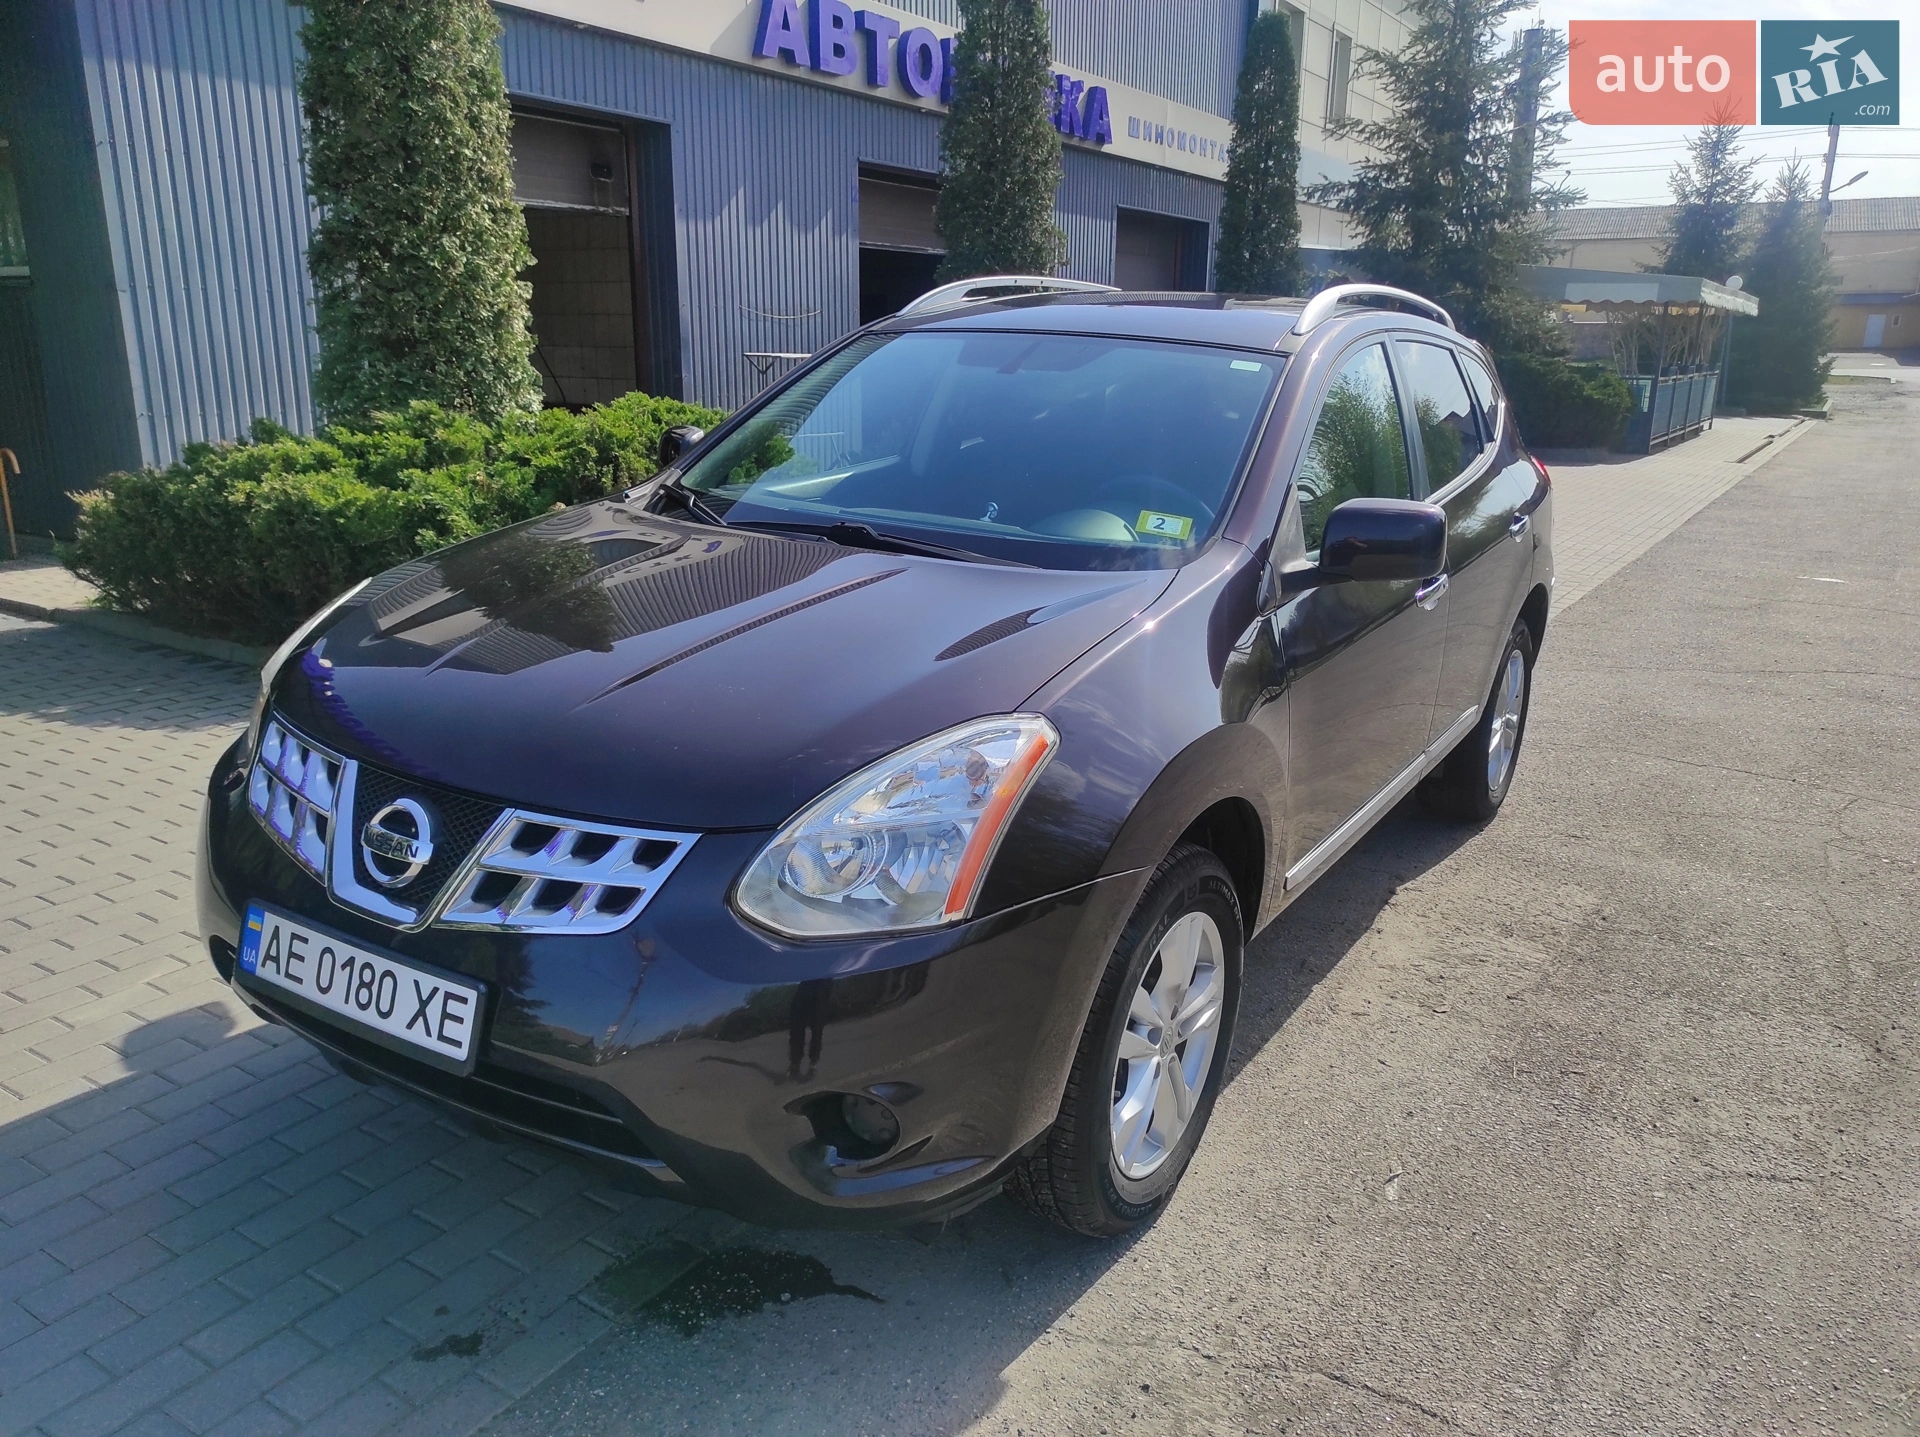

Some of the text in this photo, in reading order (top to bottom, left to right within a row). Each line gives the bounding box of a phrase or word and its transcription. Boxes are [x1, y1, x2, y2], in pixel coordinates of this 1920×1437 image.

[742, 0, 1113, 144] АВТОКА
[1128, 116, 1230, 163] ШИНОМОНТА
[1153, 517, 1166, 530] 2
[242, 946, 256, 964] UA
[260, 925, 469, 1049] AE 0180 XE
